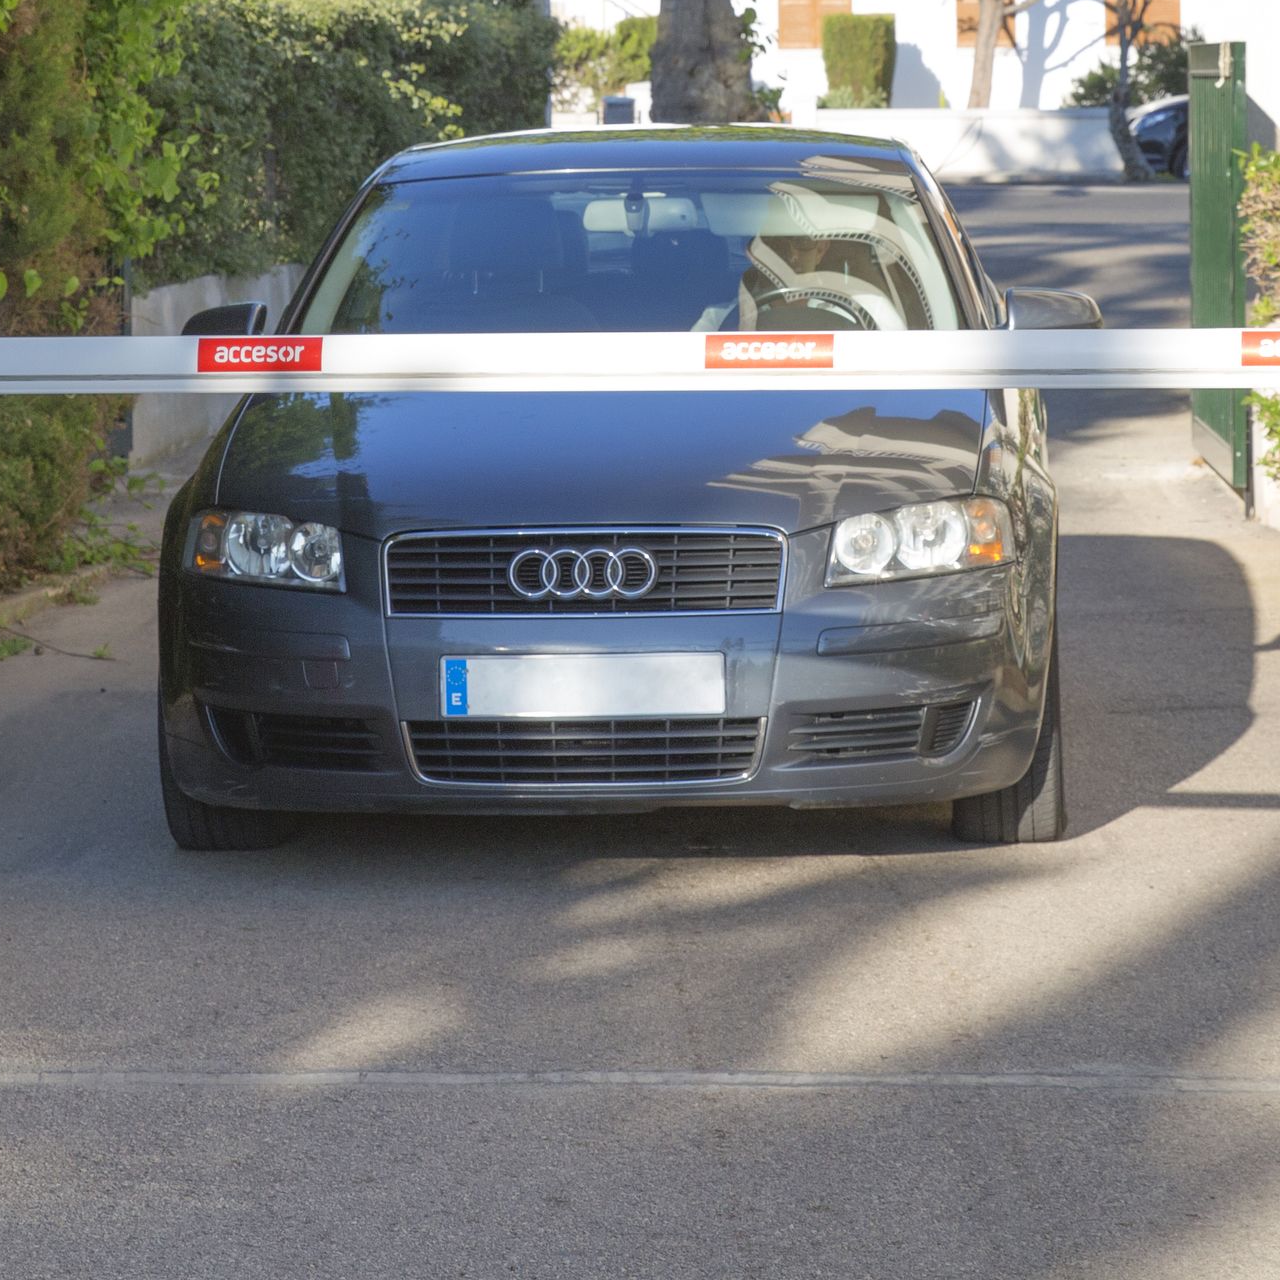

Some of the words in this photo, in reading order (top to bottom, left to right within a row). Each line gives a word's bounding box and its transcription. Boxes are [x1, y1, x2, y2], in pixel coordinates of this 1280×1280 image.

[214, 345, 305, 363] accesor
[720, 341, 817, 360] accesor
[451, 692, 462, 705] E
